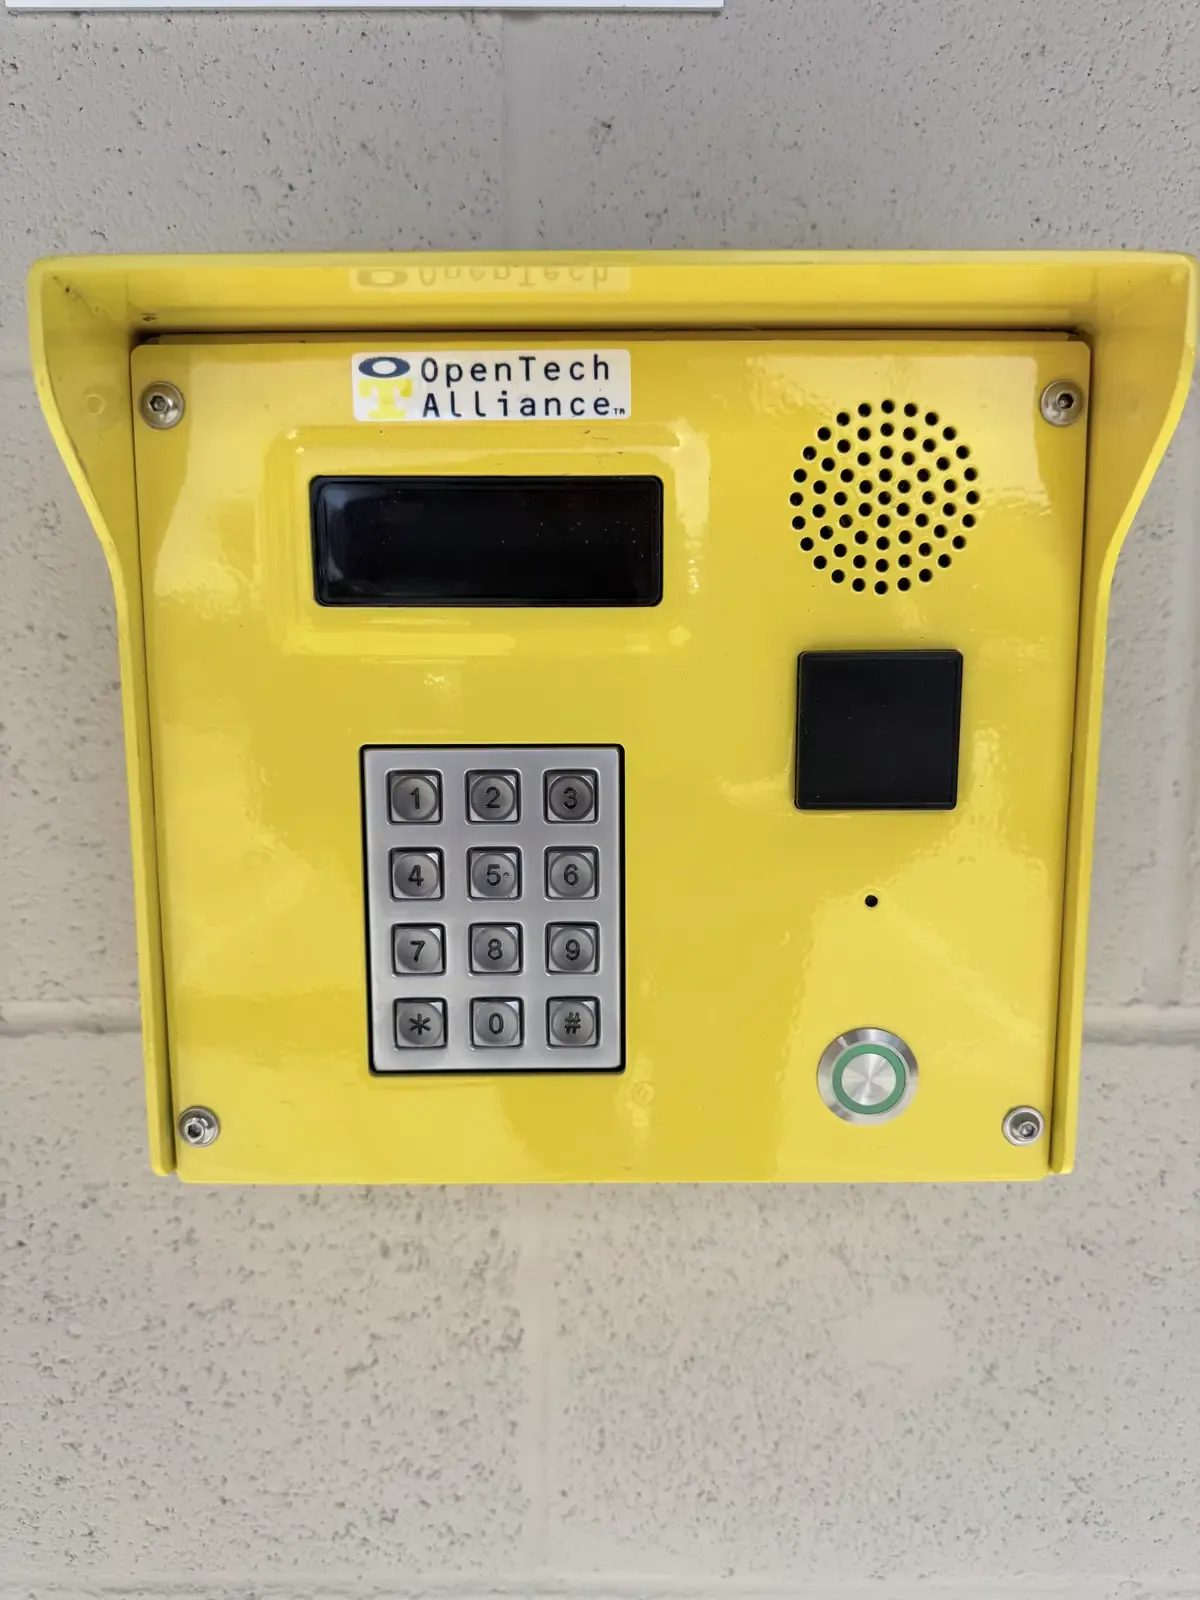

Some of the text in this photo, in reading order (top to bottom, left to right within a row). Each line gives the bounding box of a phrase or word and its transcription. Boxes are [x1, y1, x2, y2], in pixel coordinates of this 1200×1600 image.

[421, 353, 610, 388] OpenTech
[422, 390, 611, 418] Alliance
[408, 786, 578, 810] 1 2 3
[407, 863, 579, 887] 4 5 6
[409, 938, 581, 962] 7 8 9
[488, 1012, 504, 1035] 0
